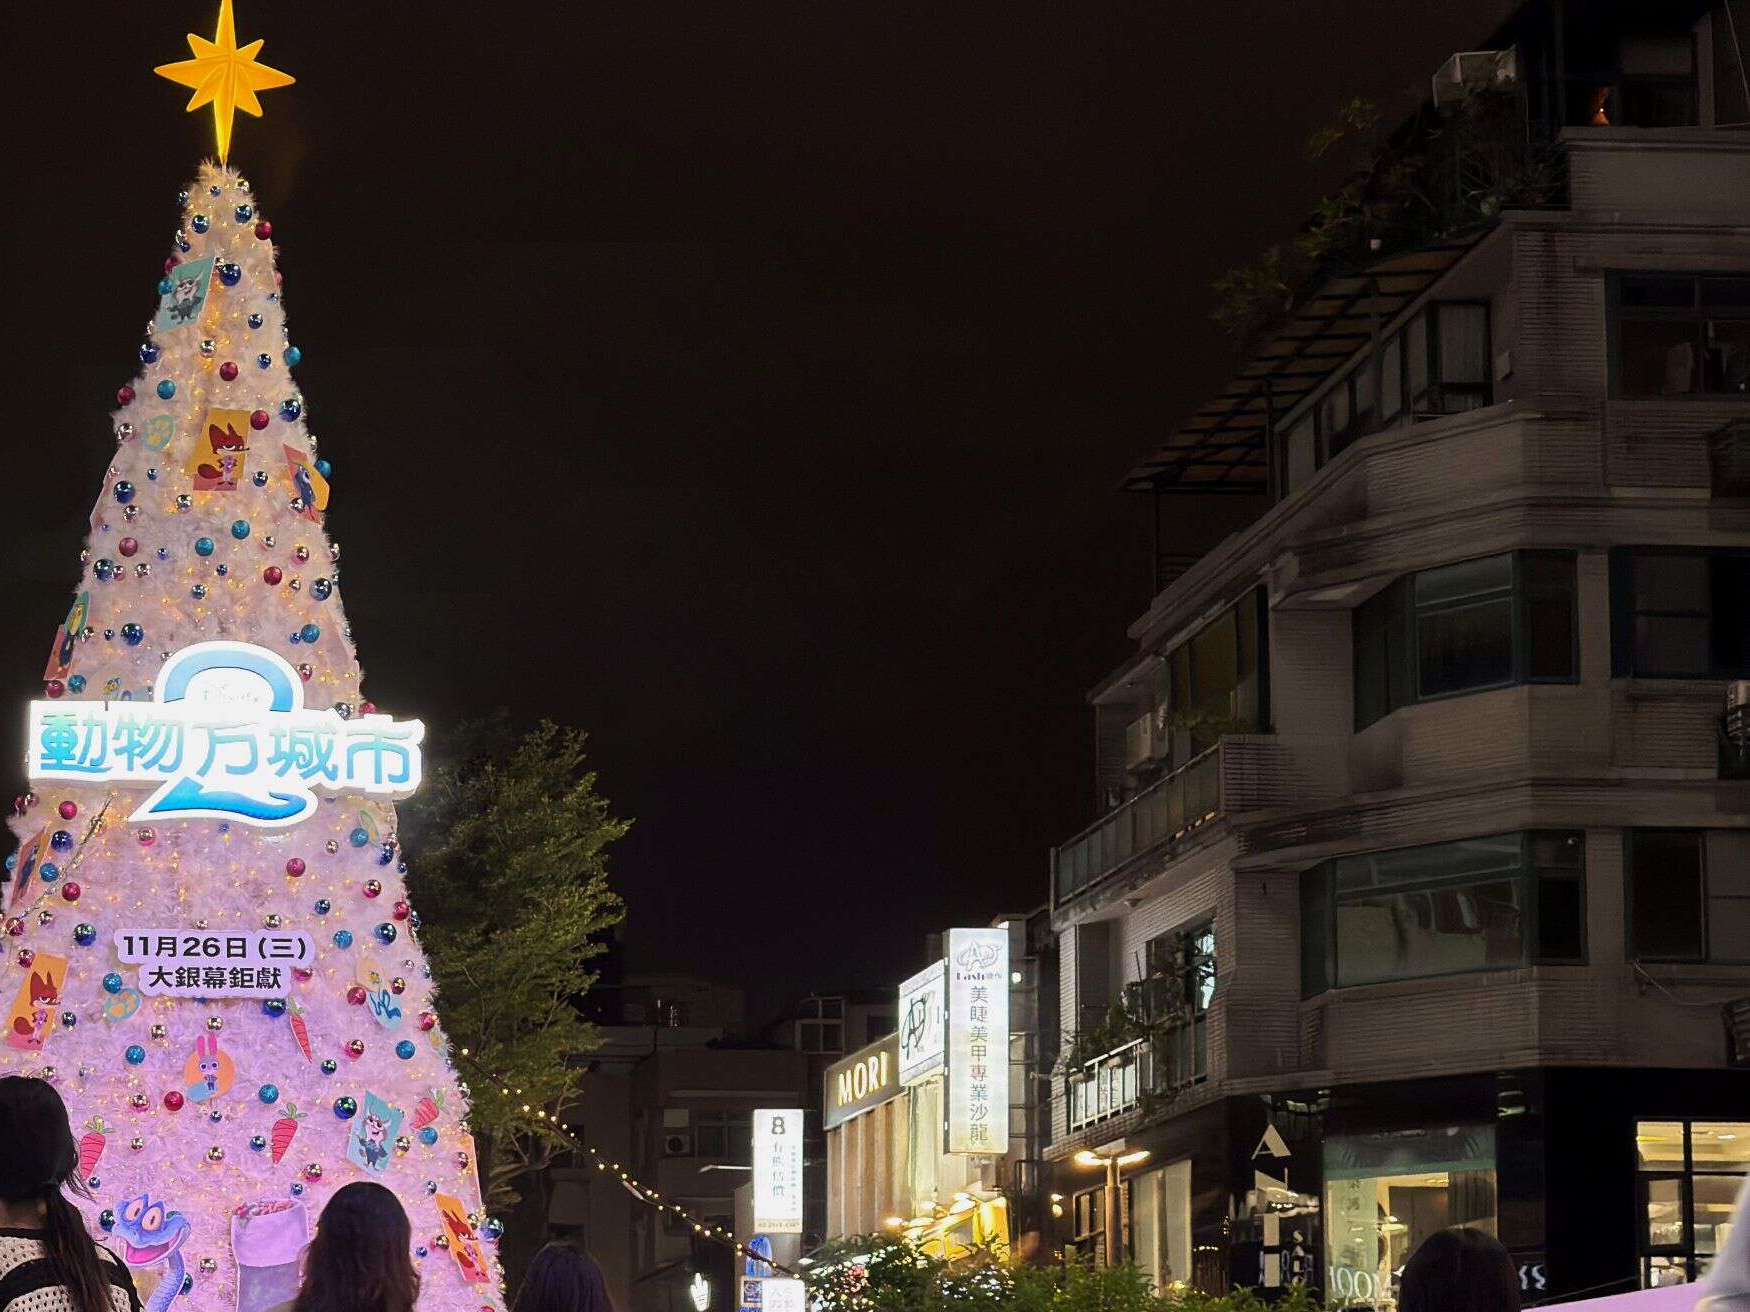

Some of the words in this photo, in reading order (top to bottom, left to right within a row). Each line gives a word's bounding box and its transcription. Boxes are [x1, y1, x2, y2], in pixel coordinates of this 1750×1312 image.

[40, 711, 414, 786] 動物方城市
[148, 966, 282, 990] 大銀幕鉅獻
[838, 1051, 888, 1107] MORI
